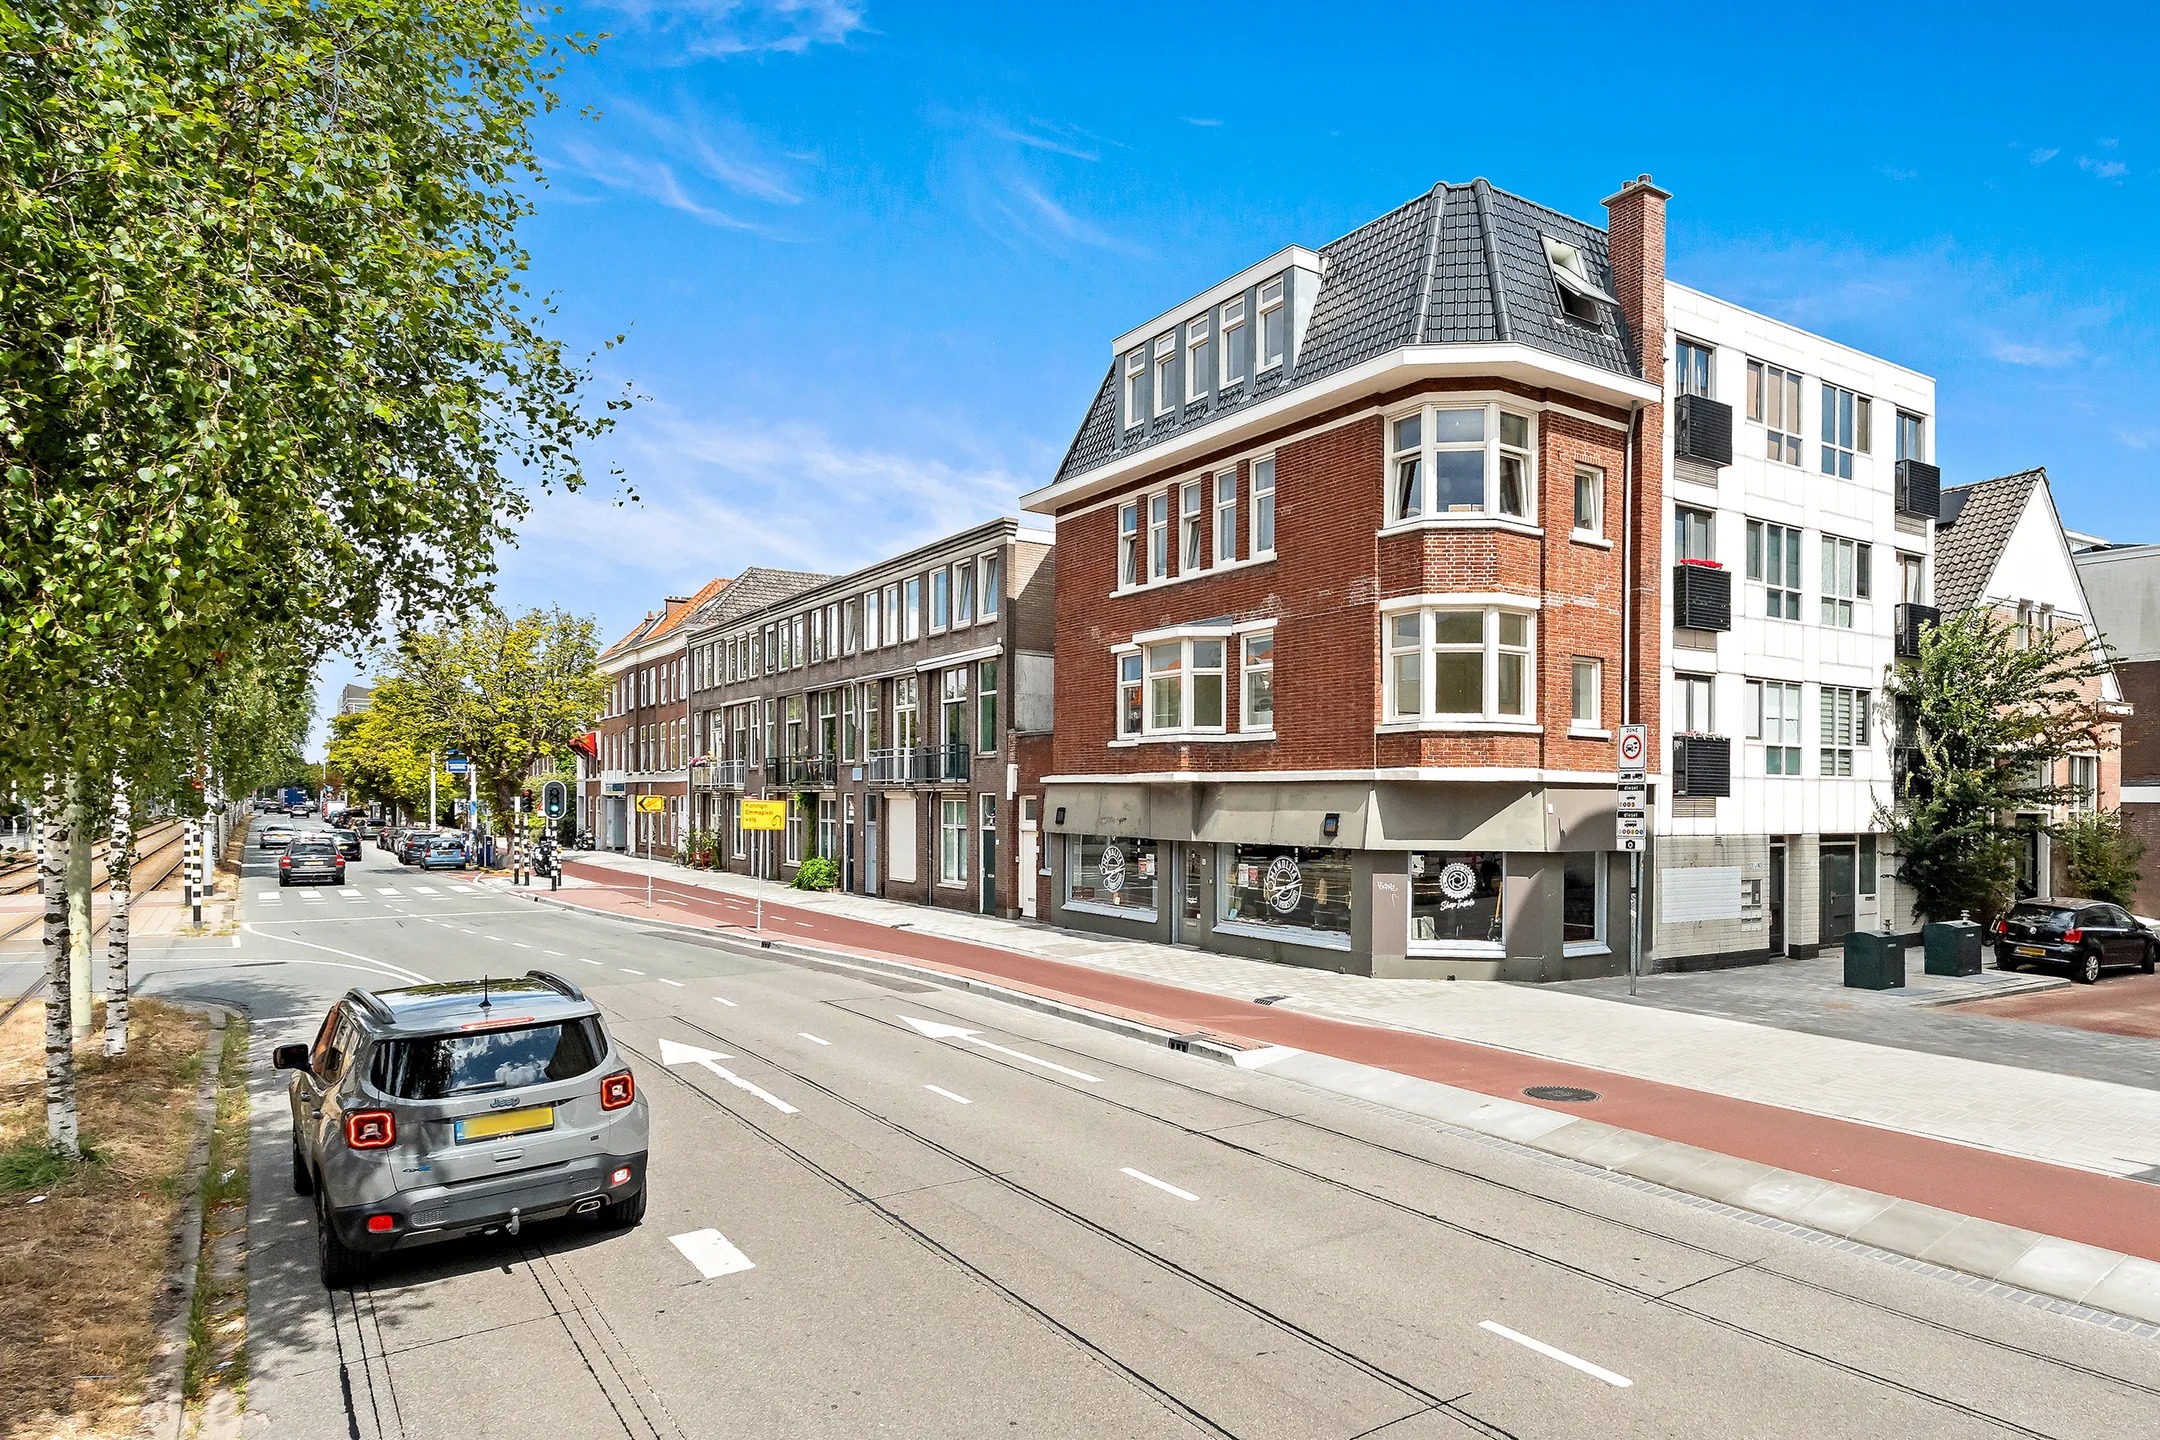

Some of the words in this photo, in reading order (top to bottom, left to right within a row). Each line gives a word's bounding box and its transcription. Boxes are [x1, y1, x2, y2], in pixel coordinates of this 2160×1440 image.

[1269, 859, 1298, 881] MANOLITA
[1440, 900, 1457, 911] Shop
[1457, 898, 1475, 909] Inside
[490, 1096, 521, 1108] Jeep
